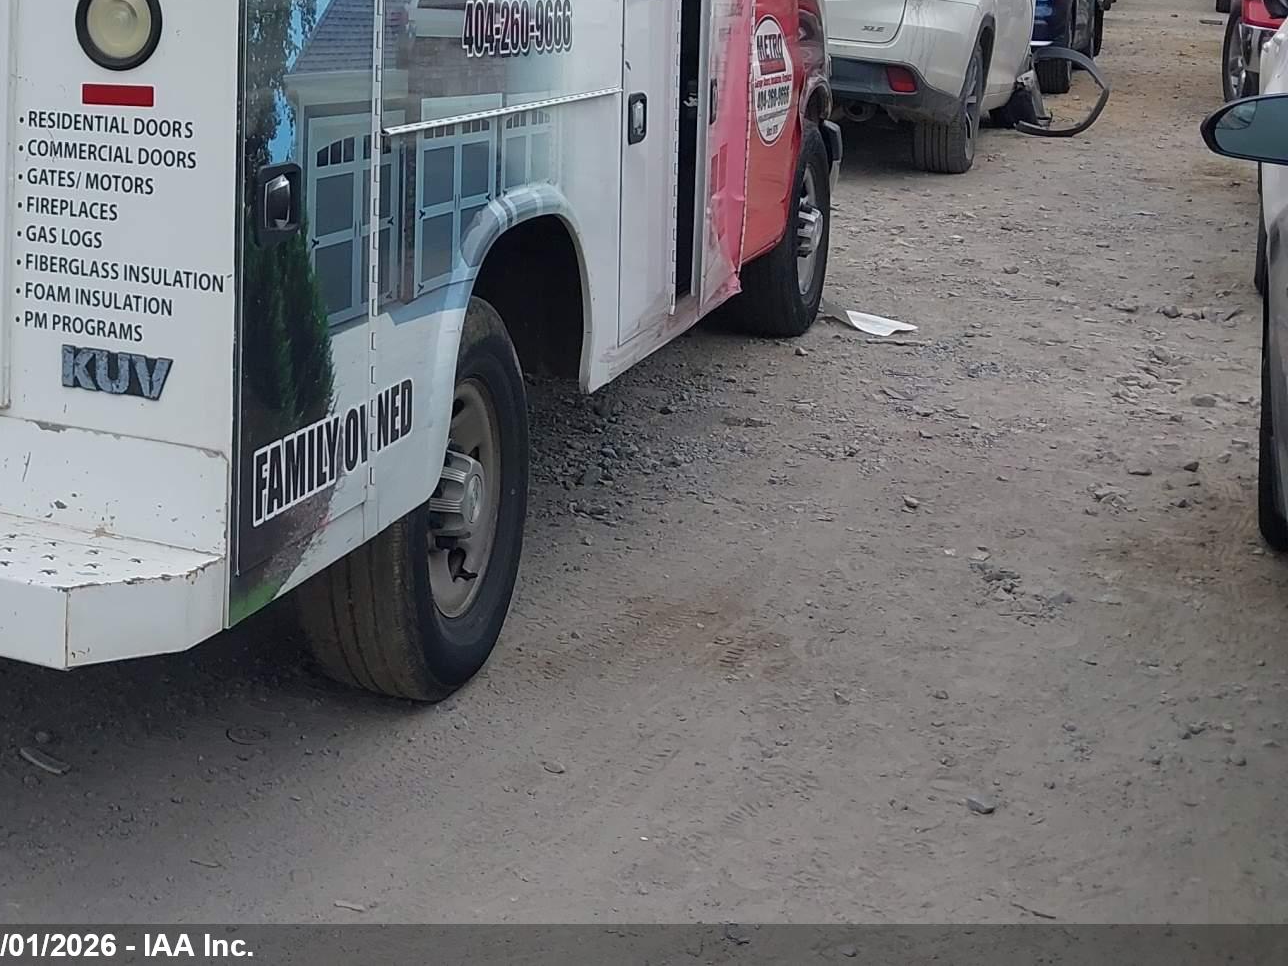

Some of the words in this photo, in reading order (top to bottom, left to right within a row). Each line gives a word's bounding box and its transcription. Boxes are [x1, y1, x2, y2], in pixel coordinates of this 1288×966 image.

[862, 25, 886, 33] XLE
[756, 33, 784, 61] METRO
[28, 110, 129, 134] RESIDENTIAL
[133, 117, 193, 139] DOORS
[27, 139, 133, 164] COMMERCIAL
[137, 147, 197, 169] DOORS
[27, 168, 82, 189] GATES/
[85, 173, 154, 195] MOTORS
[26, 196, 118, 221] FIREPLACES
[26, 225, 57, 244] GAS
[61, 228, 103, 249] LOGS
[25, 253, 119, 280] FIBERGLASS
[124, 264, 224, 293] INSULATION
[25, 282, 71, 303] FOAM
[75, 288, 173, 316] INSULATION
[24, 310, 48, 330] PM
[52, 314, 143, 342] PROGRAMS
[62, 344, 174, 401] KUV
[254, 415, 340, 525] FAMILY
